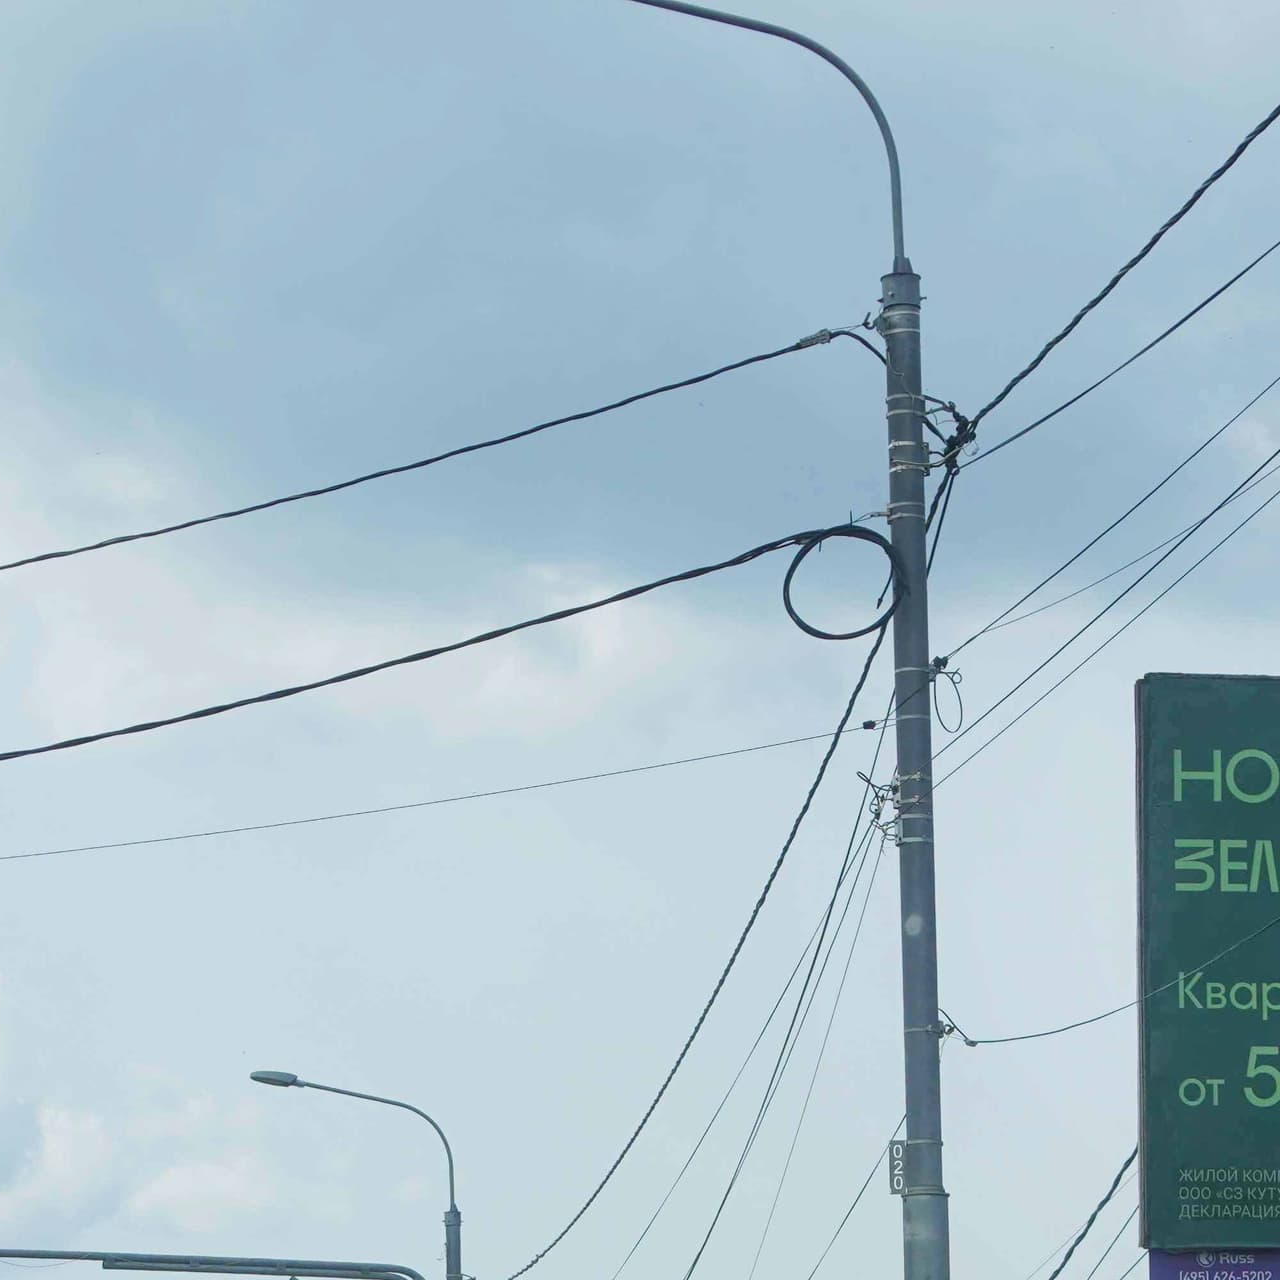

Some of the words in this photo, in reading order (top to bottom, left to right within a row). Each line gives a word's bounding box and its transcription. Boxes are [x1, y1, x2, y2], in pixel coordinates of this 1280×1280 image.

[1178, 1078, 1224, 1106] от
[892, 1144, 904, 1190] 020
[1178, 1167, 1239, 1182] ЖИЛОЙ
[1178, 1186, 1212, 1200] ООО
